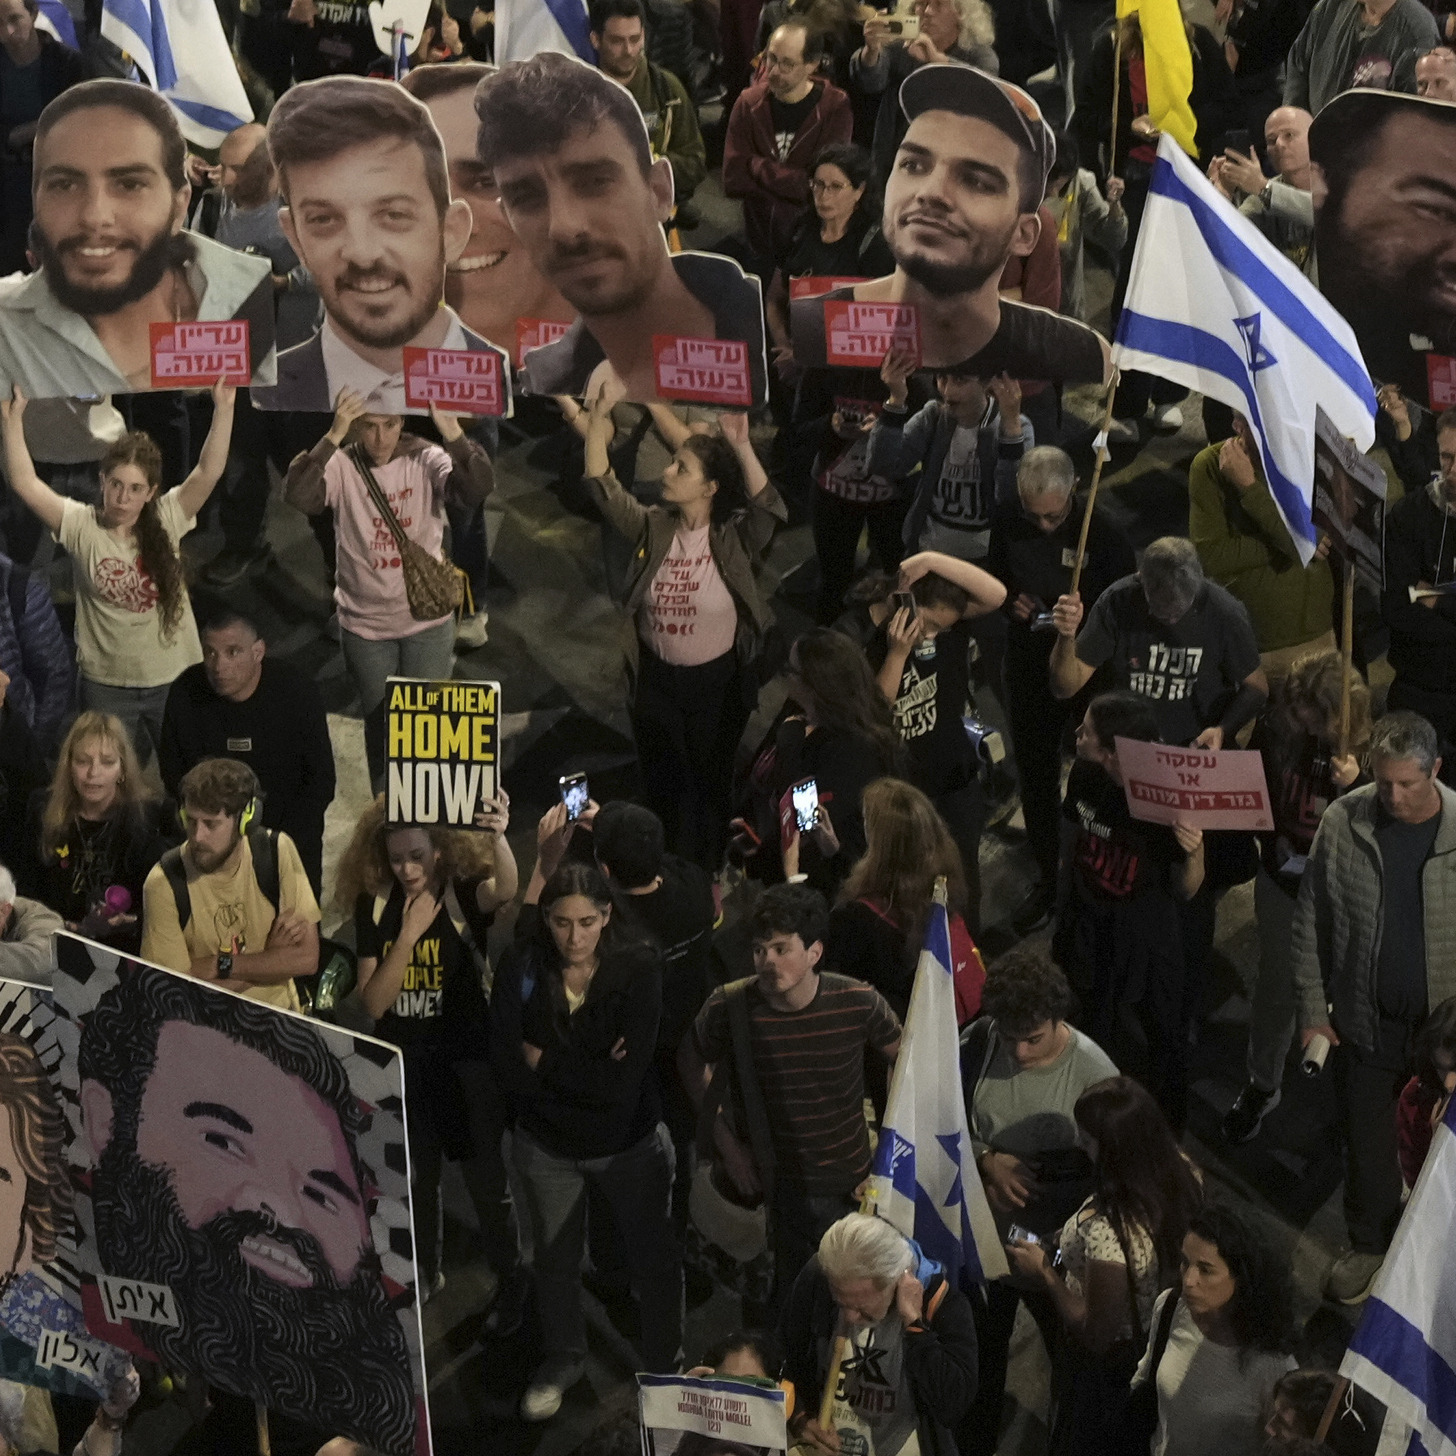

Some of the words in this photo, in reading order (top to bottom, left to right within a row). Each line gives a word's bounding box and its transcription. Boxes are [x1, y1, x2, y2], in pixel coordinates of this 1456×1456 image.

[853, 307, 913, 329] עדיין
[180, 326, 241, 349] עדיין
[840, 334, 913, 355] בעזה.
[165, 354, 244, 373] בעזה.
[681, 342, 741, 364] עדיין
[433, 355, 492, 376] עדיין
[419, 379, 494, 401] בעזה.
[669, 368, 744, 390] בעזה.
[389, 685, 429, 711] ALL
[427, 692, 439, 707] OF
[442, 686, 494, 714] THEM
[389, 713, 494, 762] HOME
[1155, 751, 1217, 768] עסקה
[1177, 772, 1200, 787] או
[388, 761, 495, 825] NOW!
[1135, 786, 1180, 805] מוות
[1187, 791, 1216, 809] דין
[1225, 792, 1257, 807] גזר
[104, 1280, 169, 1320] איתן
[42, 1333, 101, 1372] אלון
[707, 1420, 722, 1434] (21)
